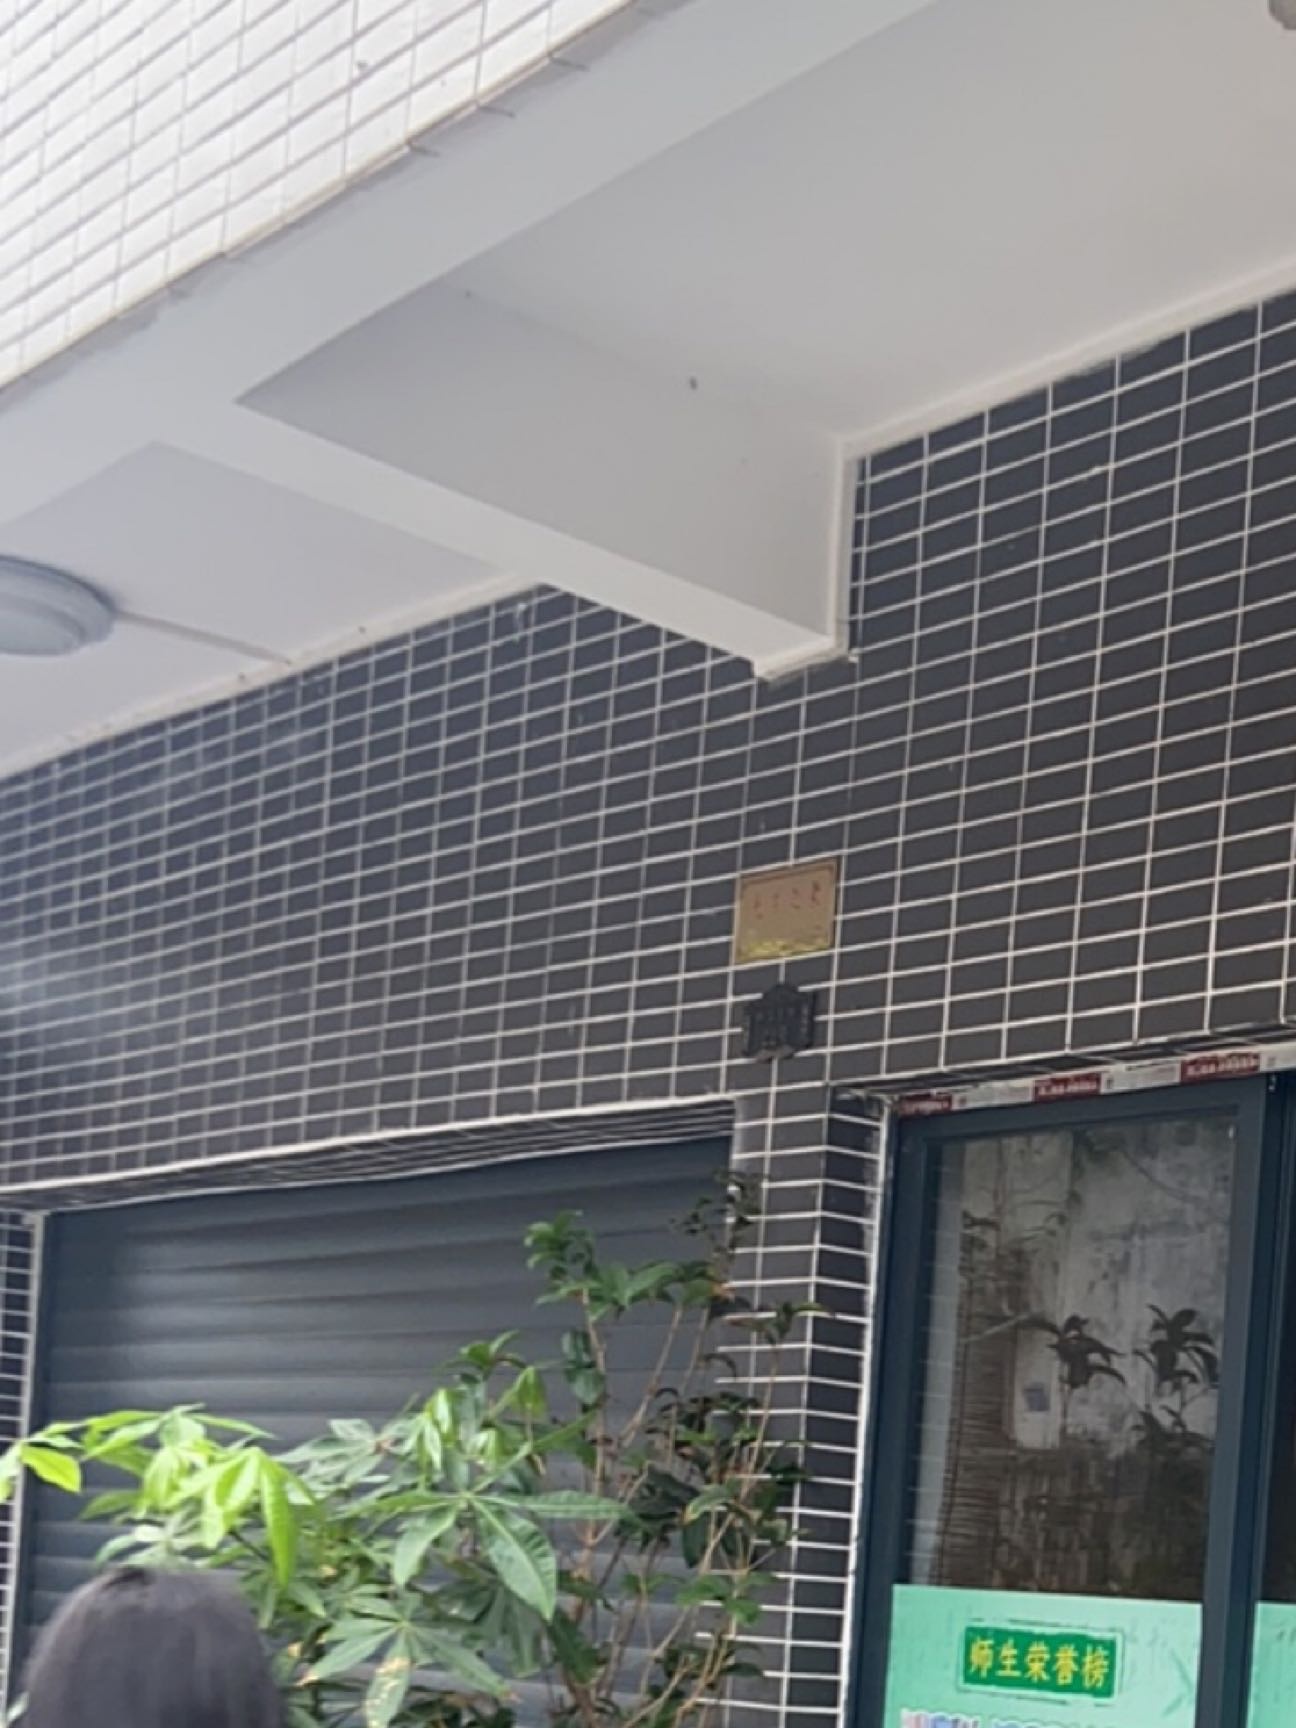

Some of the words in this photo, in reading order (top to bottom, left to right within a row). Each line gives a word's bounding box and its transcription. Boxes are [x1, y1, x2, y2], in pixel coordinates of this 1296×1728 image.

[969, 1635, 1109, 1690] 师生荣誉榜
